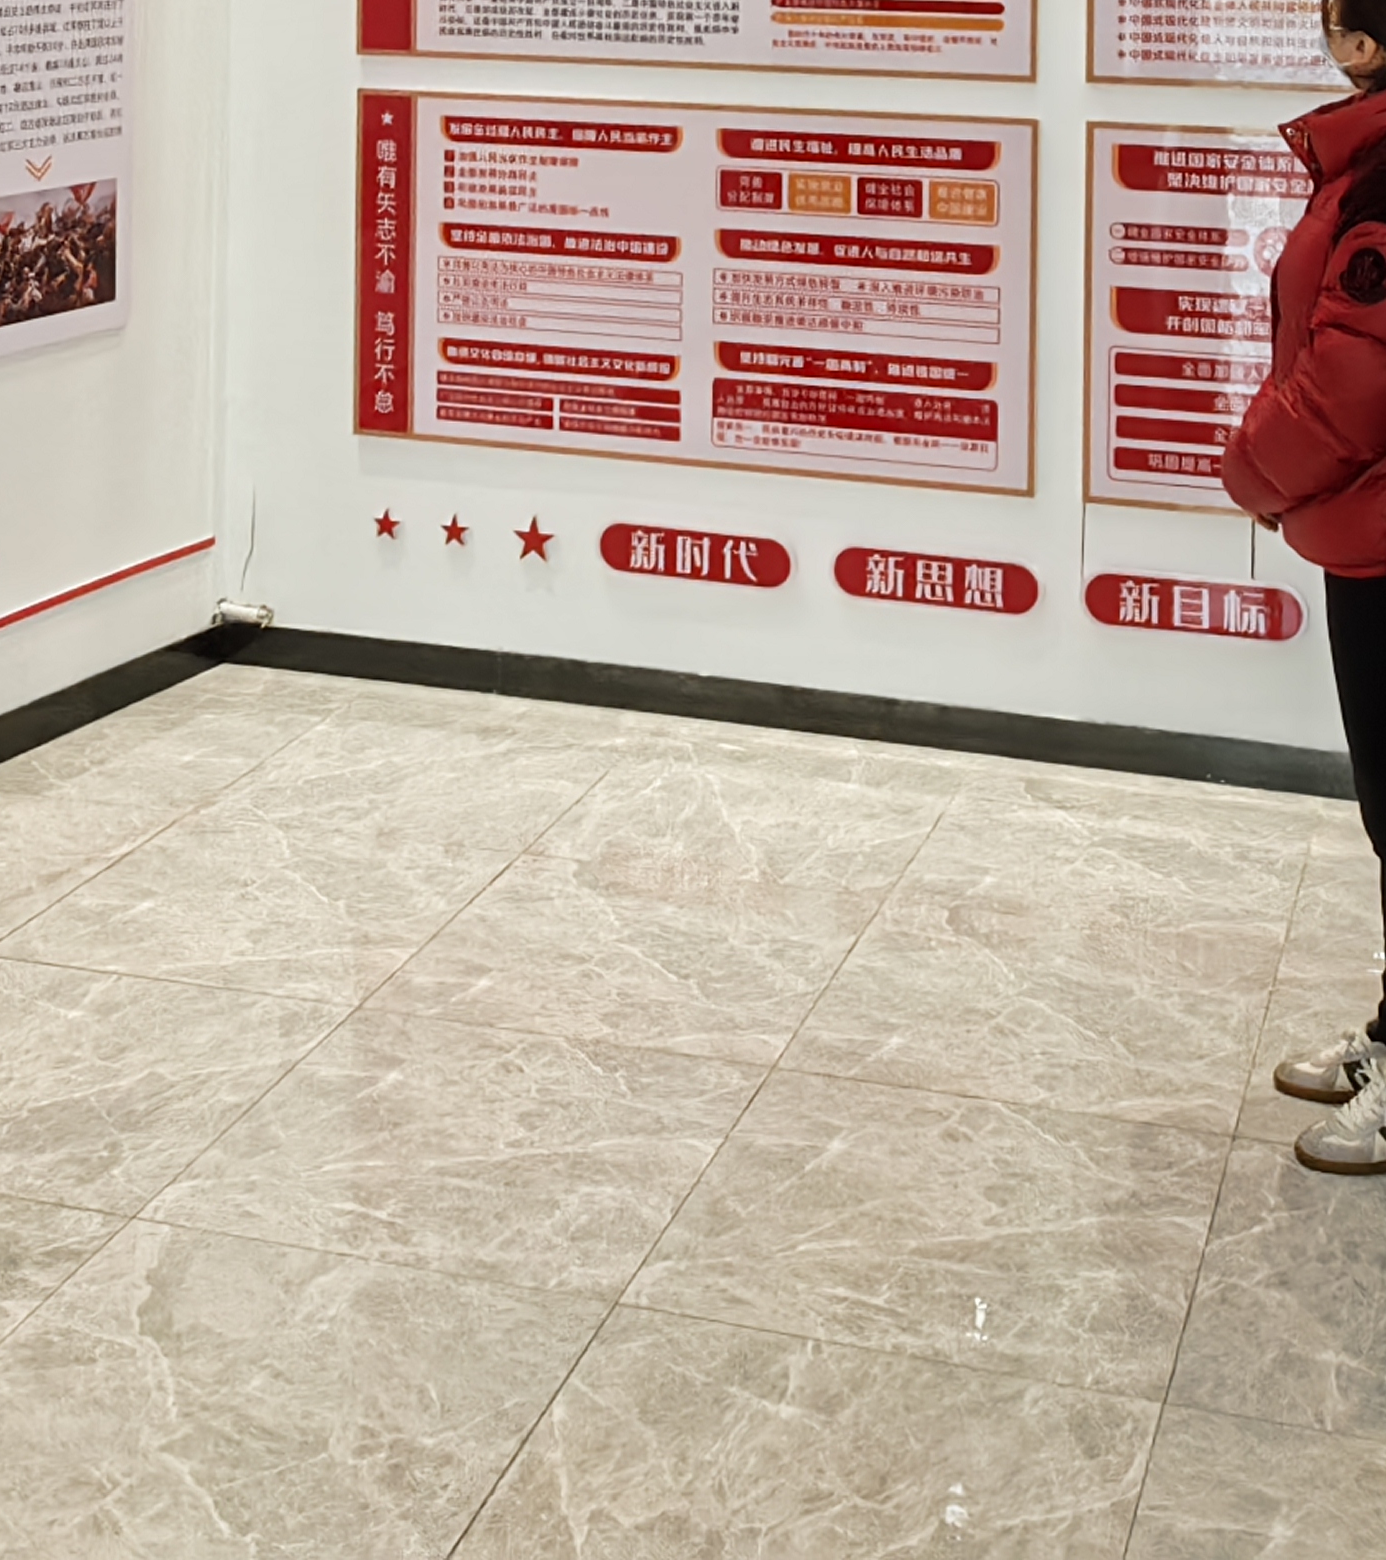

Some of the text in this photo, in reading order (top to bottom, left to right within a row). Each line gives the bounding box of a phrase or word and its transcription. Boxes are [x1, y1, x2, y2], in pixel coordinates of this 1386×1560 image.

[373, 139, 398, 415] 唯有矢志不渝 笃行不怠
[627, 531, 761, 582] 新时代
[865, 552, 1006, 610] 新思想
[1117, 578, 1269, 635] 新目标
